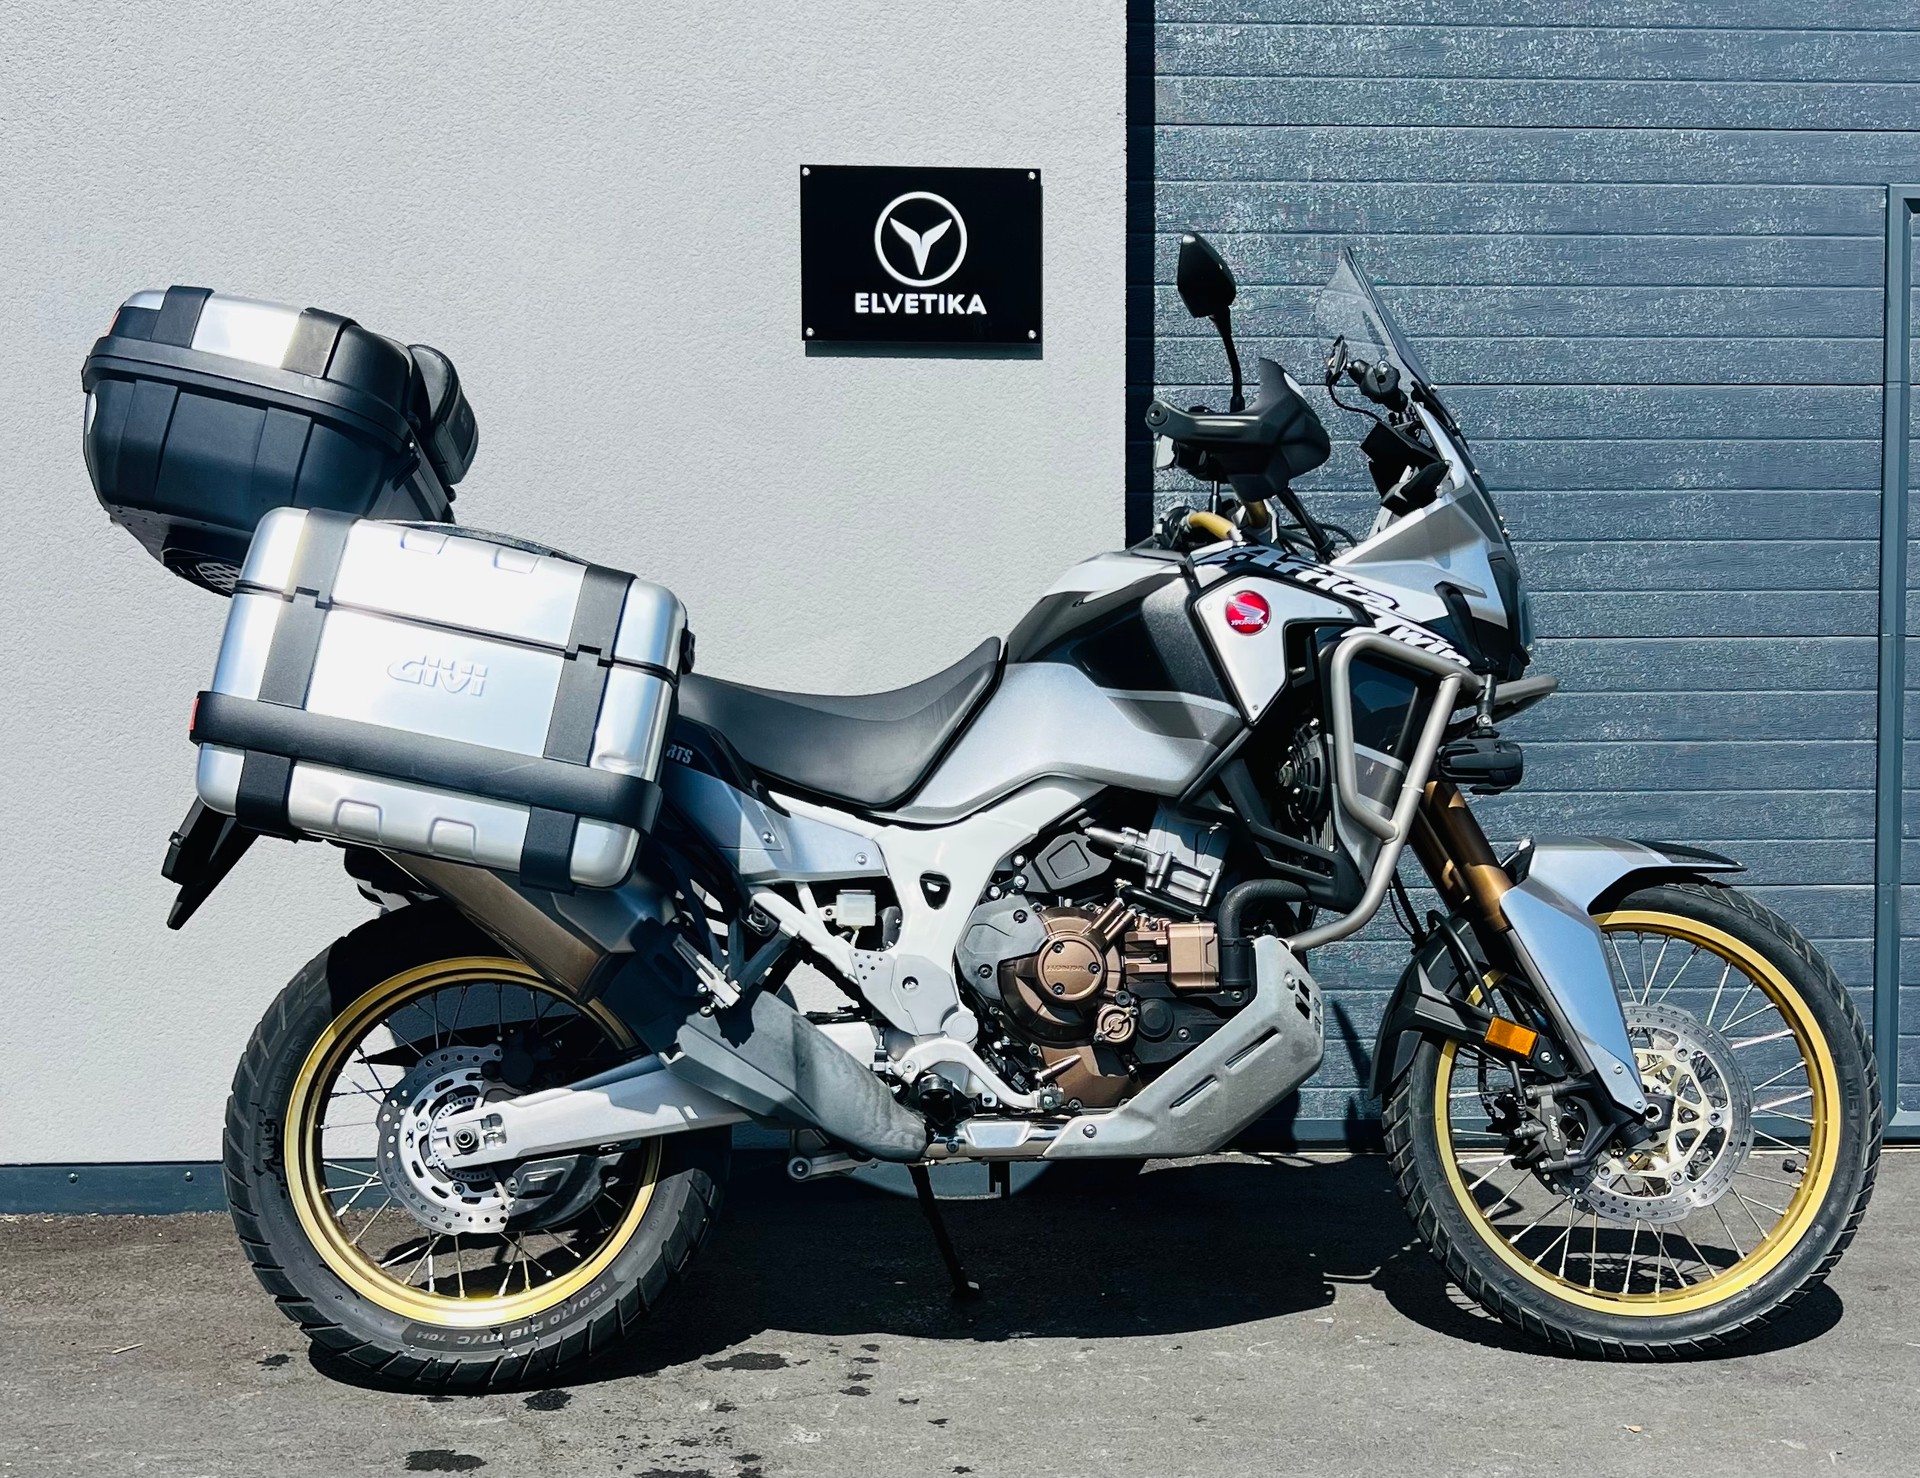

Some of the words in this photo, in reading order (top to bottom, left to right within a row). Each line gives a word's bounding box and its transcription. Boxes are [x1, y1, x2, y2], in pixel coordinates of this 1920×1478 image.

[855, 292, 987, 315] ELVETIKA
[1340, 603, 1471, 668] Twin
[387, 655, 488, 697] GIVI
[666, 744, 693, 764] RTS
[1046, 964, 1087, 972] HONDA
[550, 1282, 608, 1325] 150/70
[416, 1331, 447, 1342] 70H
[509, 1320, 544, 1340] R18
